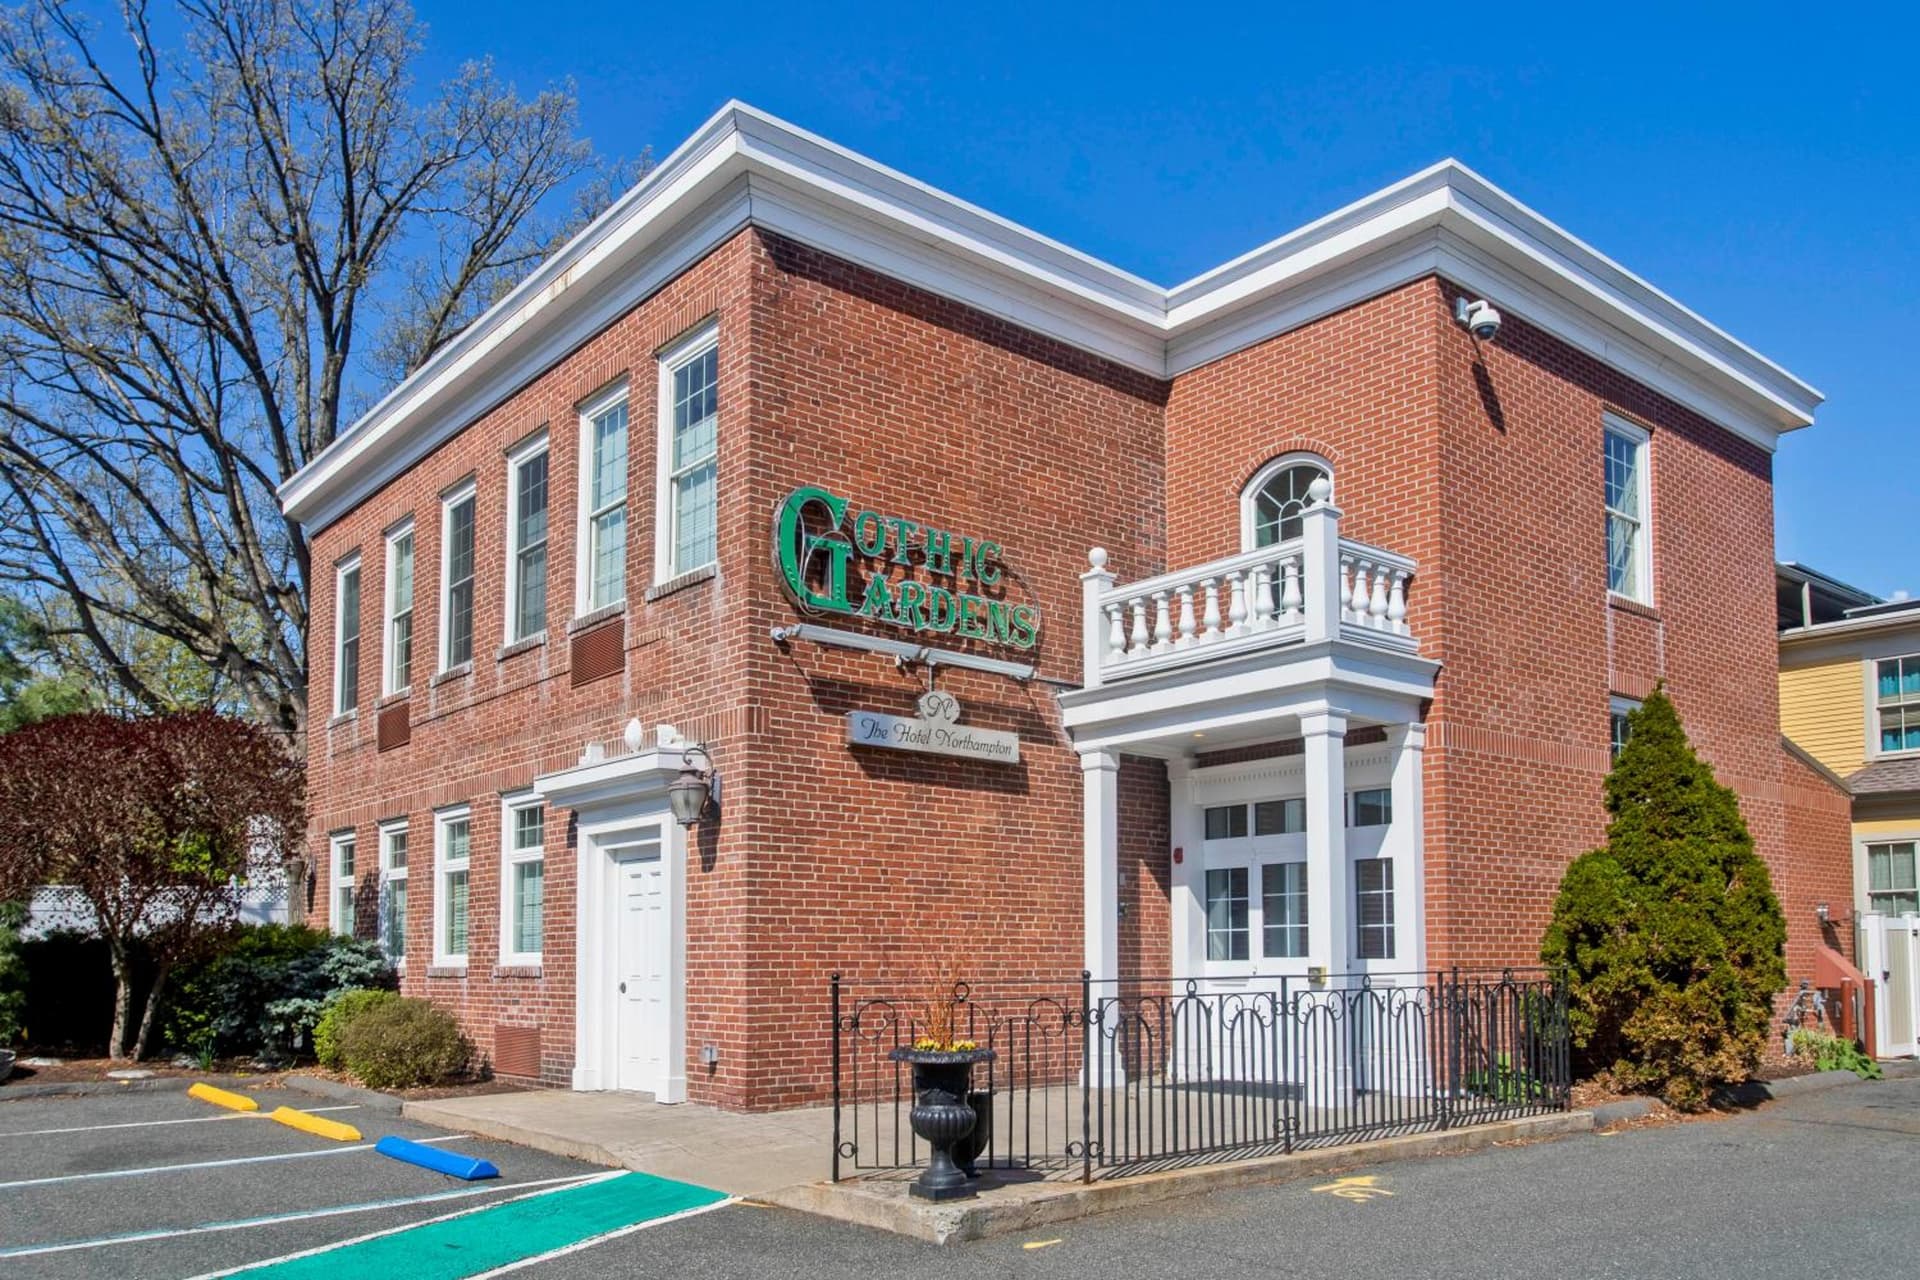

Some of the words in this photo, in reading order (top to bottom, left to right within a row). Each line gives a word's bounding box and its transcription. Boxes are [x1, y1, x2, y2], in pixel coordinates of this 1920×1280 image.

[860, 718, 888, 740] The
[893, 722, 931, 745] Hotel
[935, 728, 1013, 756] Northampton
